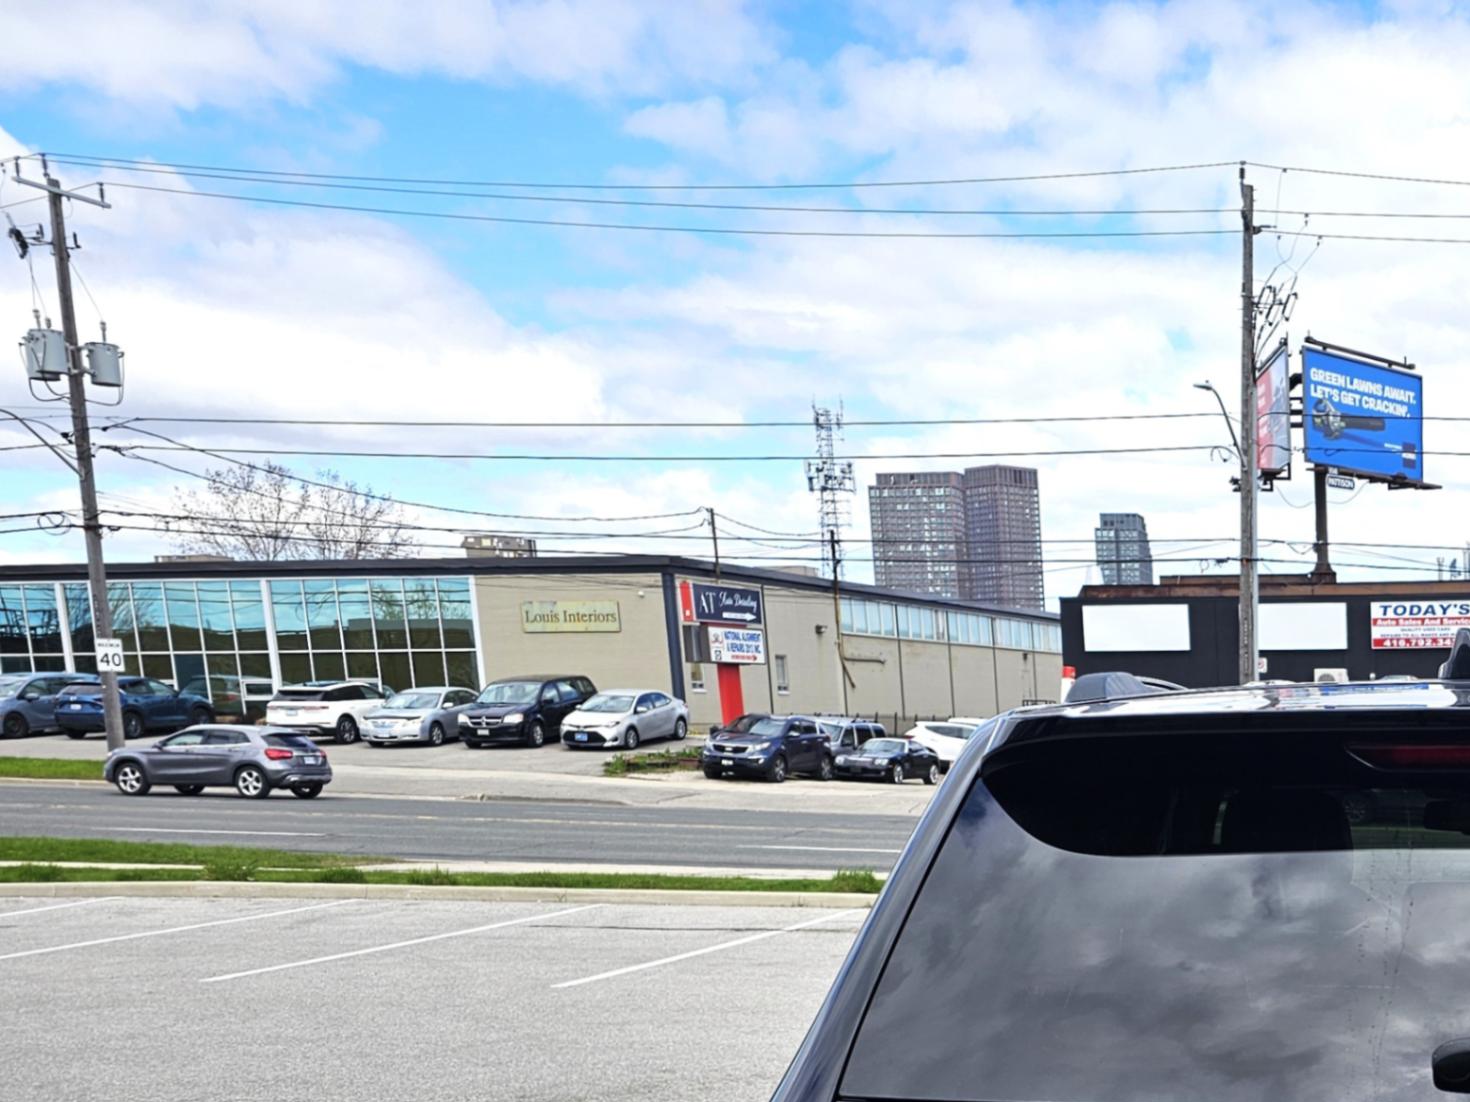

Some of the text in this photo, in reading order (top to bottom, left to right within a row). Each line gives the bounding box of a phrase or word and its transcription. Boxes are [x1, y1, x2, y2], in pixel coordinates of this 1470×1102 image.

[1310, 367, 1417, 405] GREEN LAWNS AWAIT.
[1310, 384, 1411, 418] LET'S GET CRACKIN'.
[525, 609, 617, 623] Louis Interiors
[1380, 604, 1470, 616] TODAY'S
[1383, 639, 1456, 647] 416.792.34
[100, 653, 122, 667] 40
